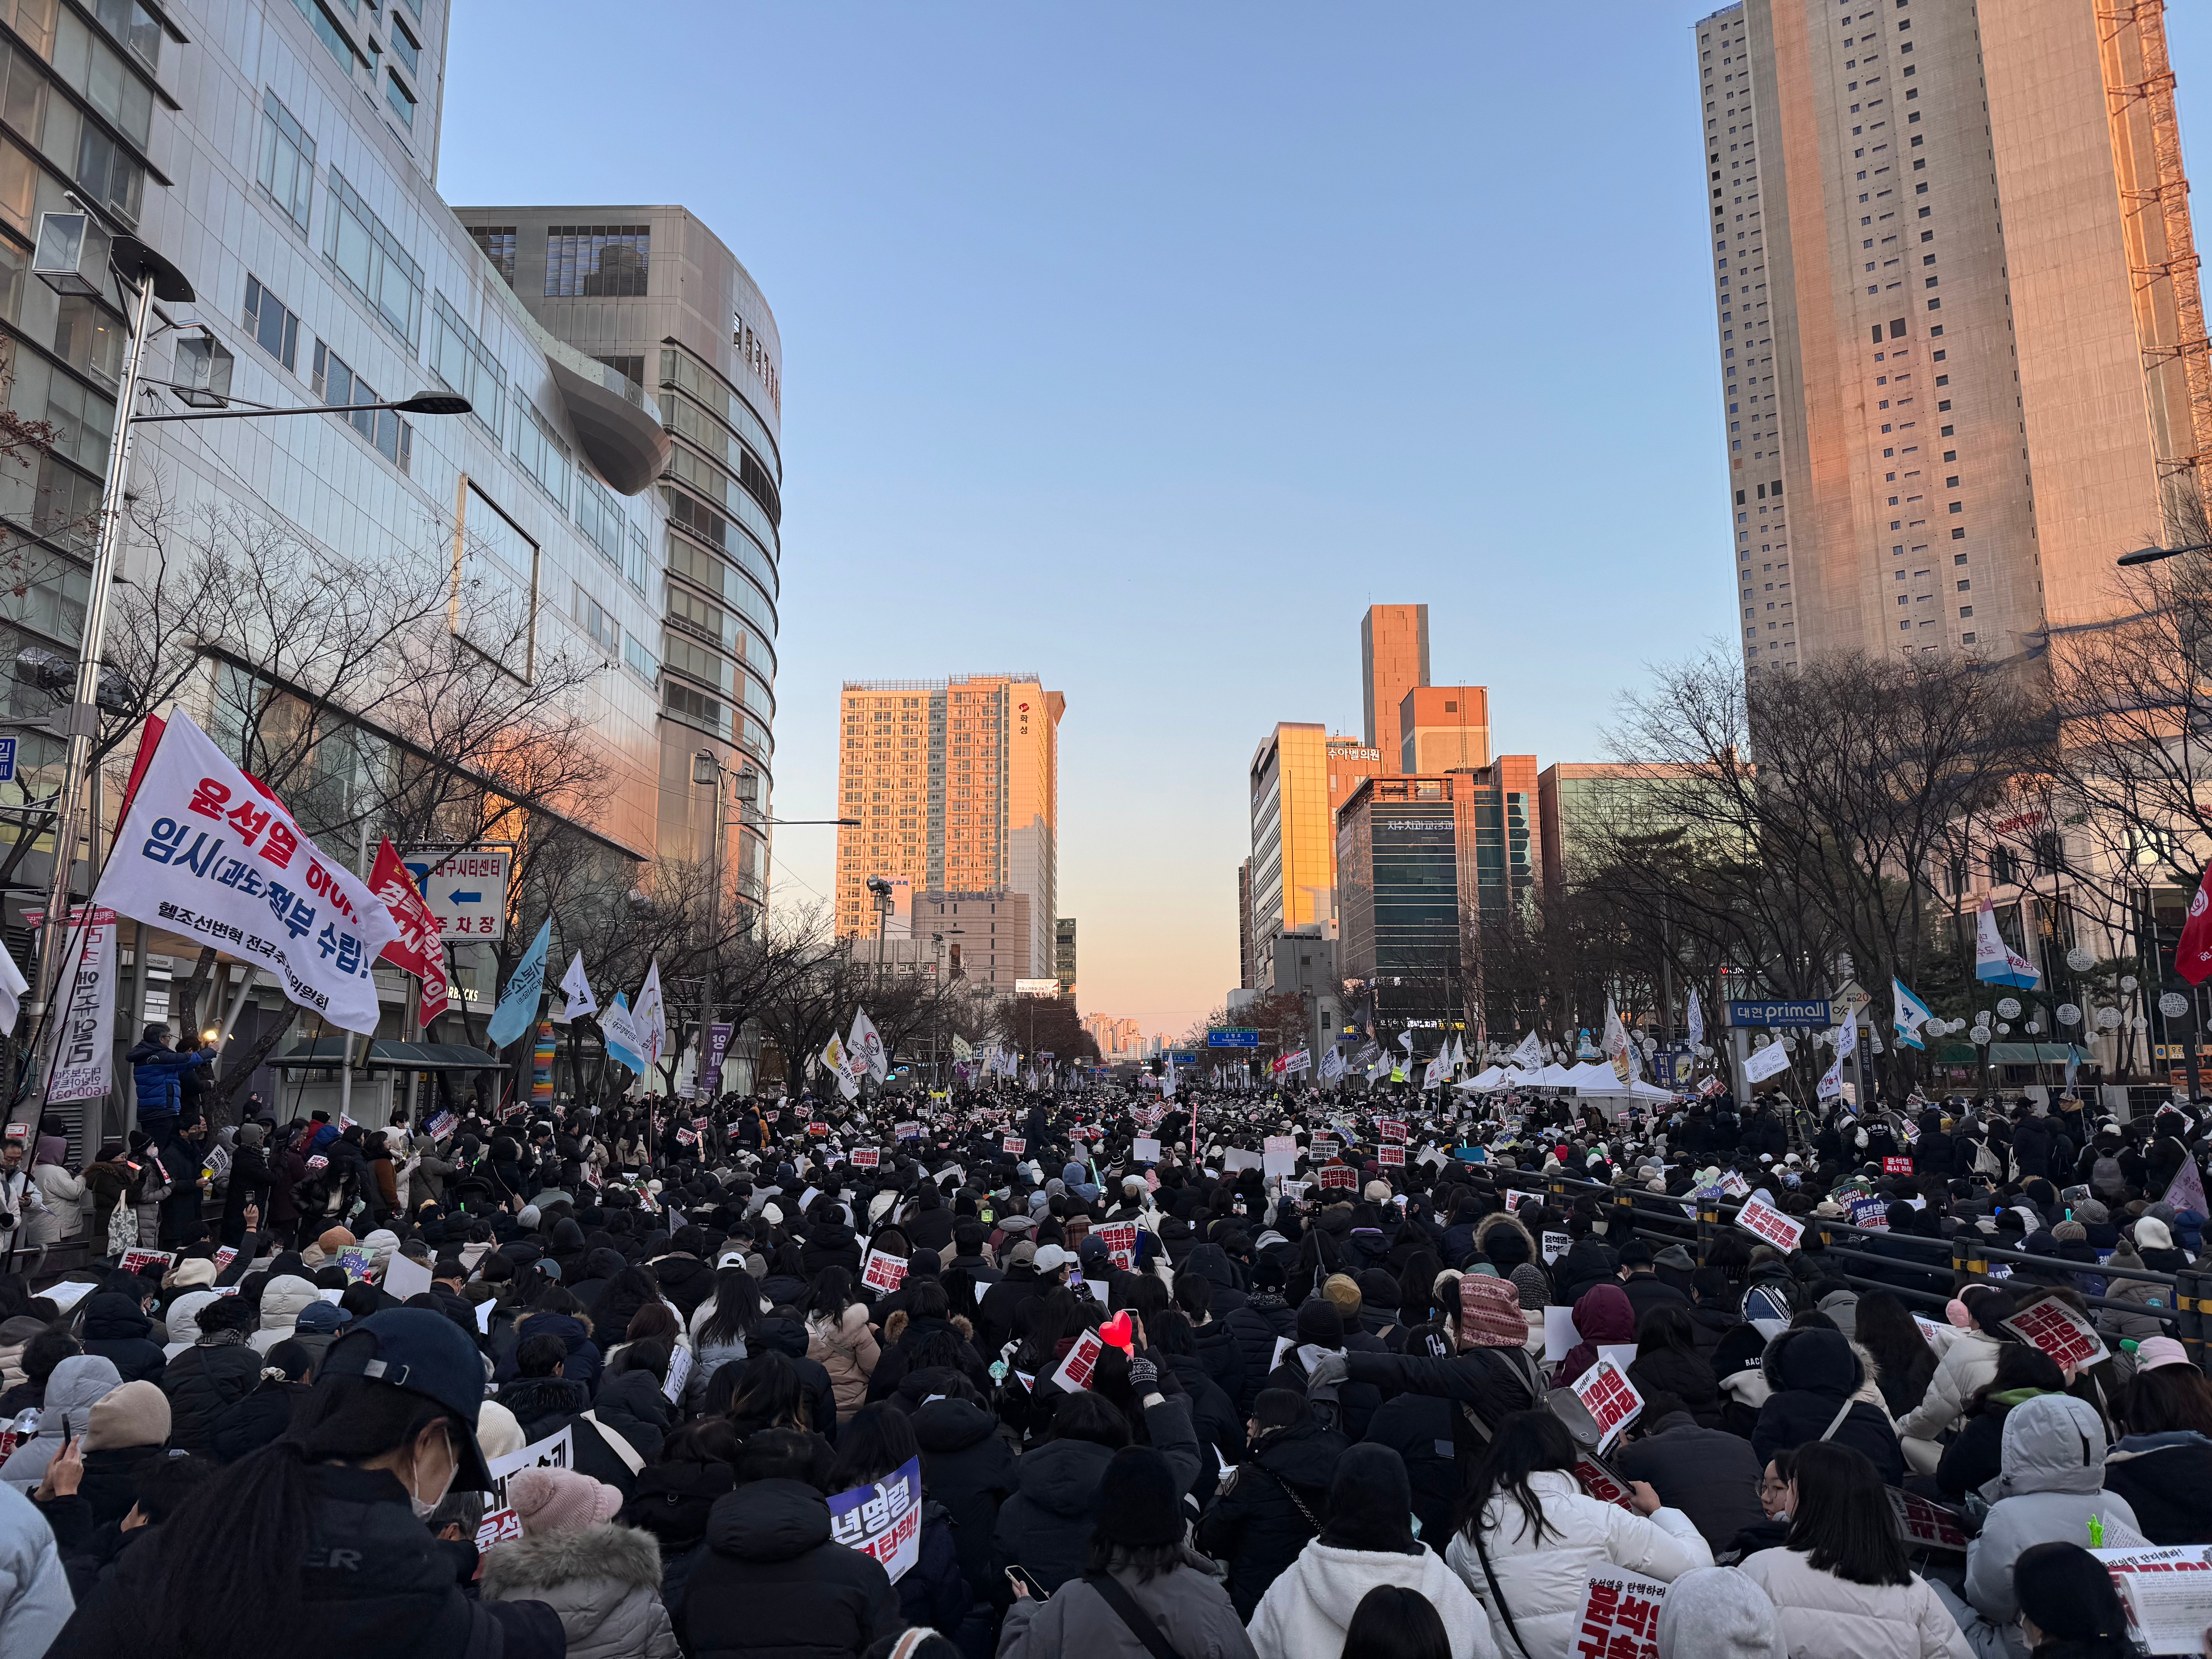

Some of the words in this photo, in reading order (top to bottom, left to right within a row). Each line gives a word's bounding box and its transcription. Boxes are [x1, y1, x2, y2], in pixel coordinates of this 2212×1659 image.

[1020, 714, 1028, 735] 화성
[1328, 748, 1380, 761] 수아벨의원
[188, 777, 298, 869] 윤석열
[142, 817, 316, 939] 임시(과도)정부
[436, 859, 500, 878] 대구시티센터
[158, 901, 244, 945] 헬조선변혁
[436, 916, 495, 934] 주차장
[317, 922, 369, 979] 수립!
[446, 986, 479, 1002] RBCKS
[1856, 993, 1869, 1002] 20
[1737, 1007, 1763, 1018] 대현
[1765, 1002, 1824, 1024] primall
[1839, 1189, 1860, 1204] 탄핵이
[1857, 1200, 1891, 1219] 청년명
[1746, 1203, 1798, 1241] 윤석열을
[1096, 1227, 1136, 1240] 민의힘
[866, 1269, 901, 1291] 해체하
[1745, 1357, 1762, 1366] BAC
[1580, 1366, 1625, 1413] 민의힘
[833, 1475, 909, 1539] 년명령
[878, 1504, 919, 1565] 탄핵!
[2107, 1555, 2138, 1567] 민의힘
[2140, 1549, 2184, 1563] 단디해라!
[1585, 1585, 1661, 1642] 윤석
